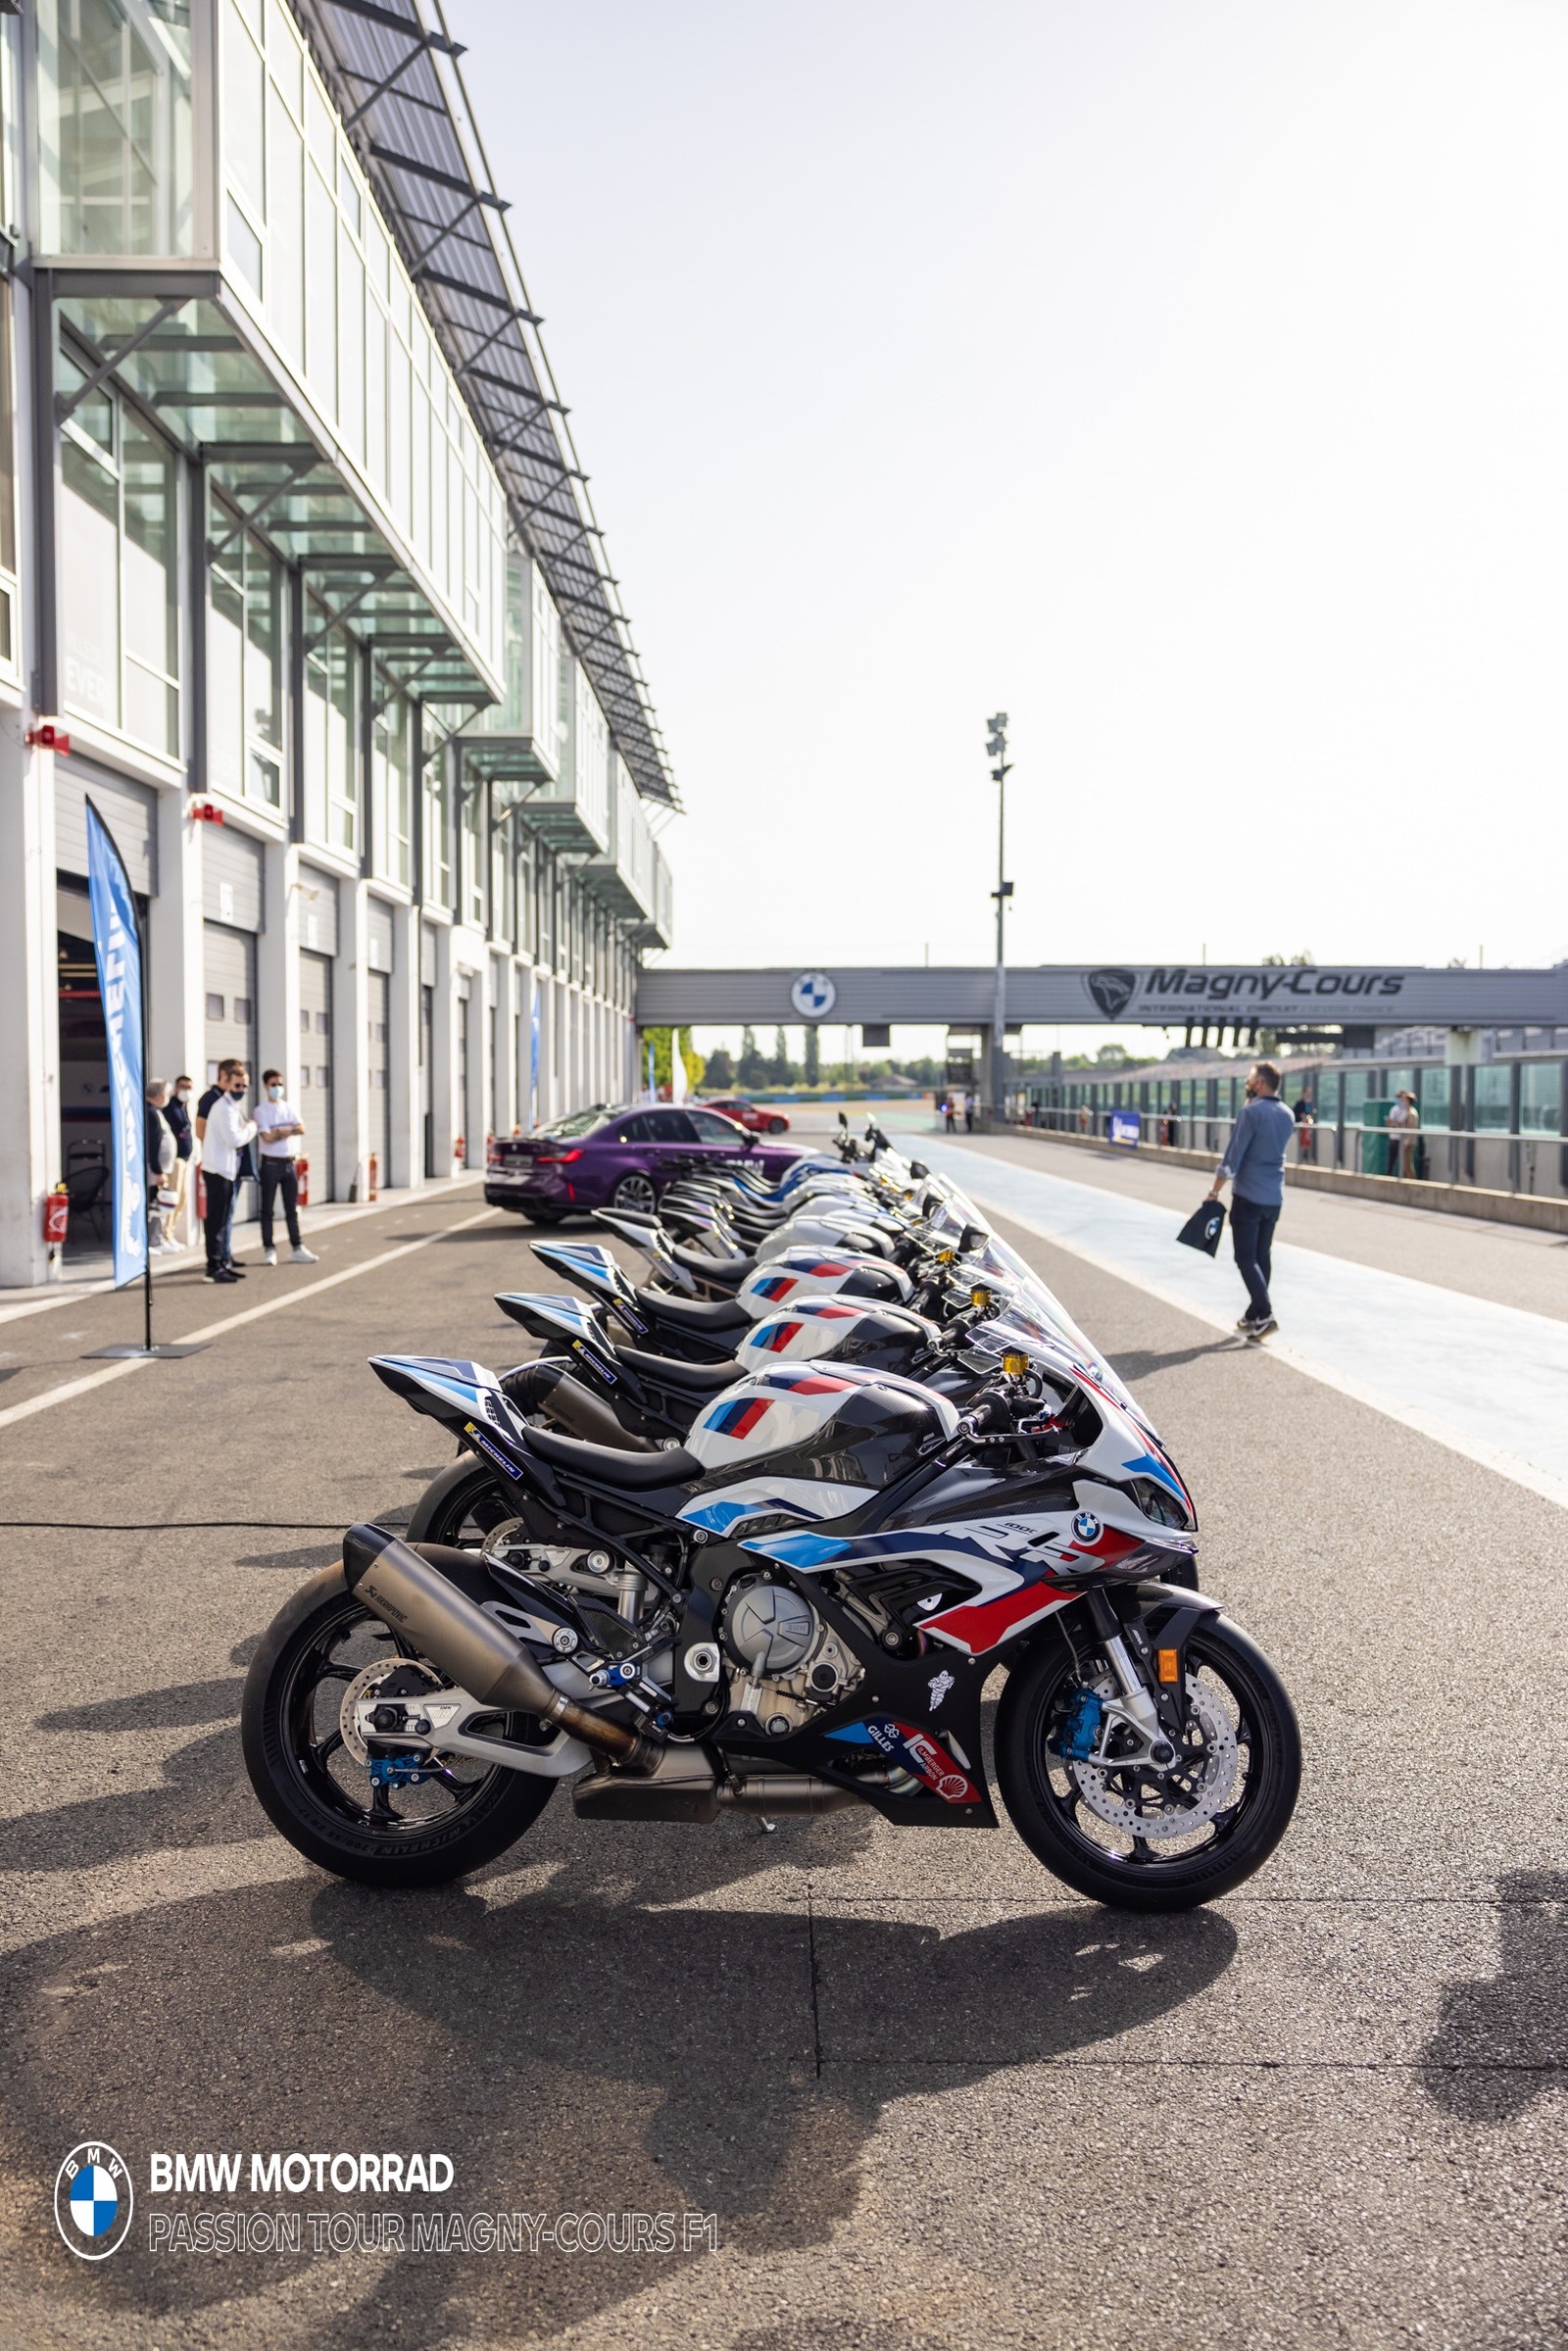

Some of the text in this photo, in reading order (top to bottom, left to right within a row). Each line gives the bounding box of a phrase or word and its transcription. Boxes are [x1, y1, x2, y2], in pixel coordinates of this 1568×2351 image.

[1146, 968, 1405, 1001] Magny-Cours
[480, 1440, 515, 1473] MICHELIN
[867, 1725, 895, 1752] GILLES
[916, 1745, 945, 1777] ILMBERGER
